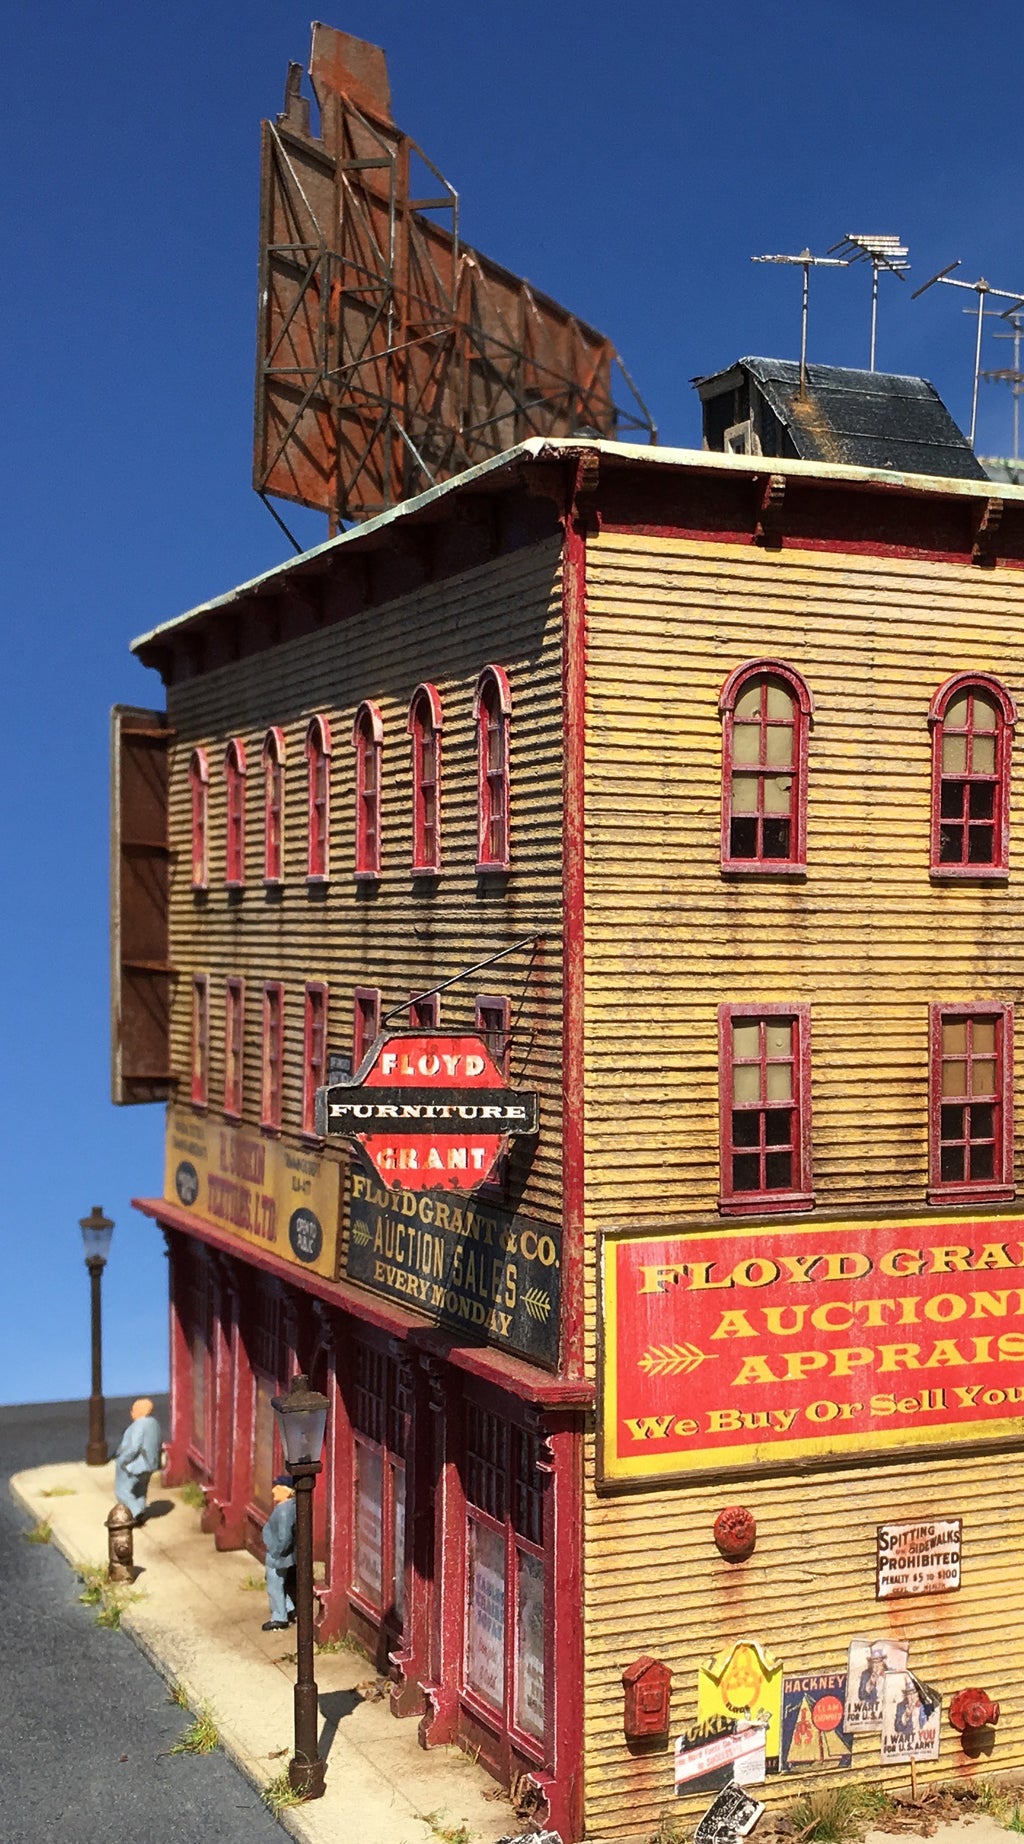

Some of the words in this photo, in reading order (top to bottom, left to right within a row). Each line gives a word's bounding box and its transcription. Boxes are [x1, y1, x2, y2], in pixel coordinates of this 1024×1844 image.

[381, 1052, 486, 1078] FLOYD
[329, 1104, 526, 1119] FURNITURE
[376, 1147, 486, 1170] GRANT
[373, 1216, 445, 1280] AUCTION
[453, 1245, 517, 1309] SALES
[638, 1252, 873, 1294] FLOYD
[373, 1260, 430, 1300] EVERY
[431, 1283, 513, 1337] MONDAY
[623, 1414, 700, 1441] We
[704, 1408, 800, 1433] Buy
[805, 1400, 864, 1422] Or
[869, 1387, 948, 1417] Sell
[880, 1526, 936, 1551] SPITTING
[909, 1530, 960, 1554] SIDEWALKS
[879, 1551, 960, 1572] PROHIBITED
[881, 1574, 909, 1585] PENALTY
[913, 1572, 924, 1583] $5
[937, 1569, 957, 1580] $100
[784, 1675, 846, 1693] HACKNEY
[847, 1713, 860, 1722] FOR
[854, 1701, 880, 1712] WANT
[883, 1745, 896, 1754] FOR
[915, 1741, 935, 1750] ARMY
[890, 1734, 916, 1745] WANT
[918, 1729, 936, 1742] YOU
